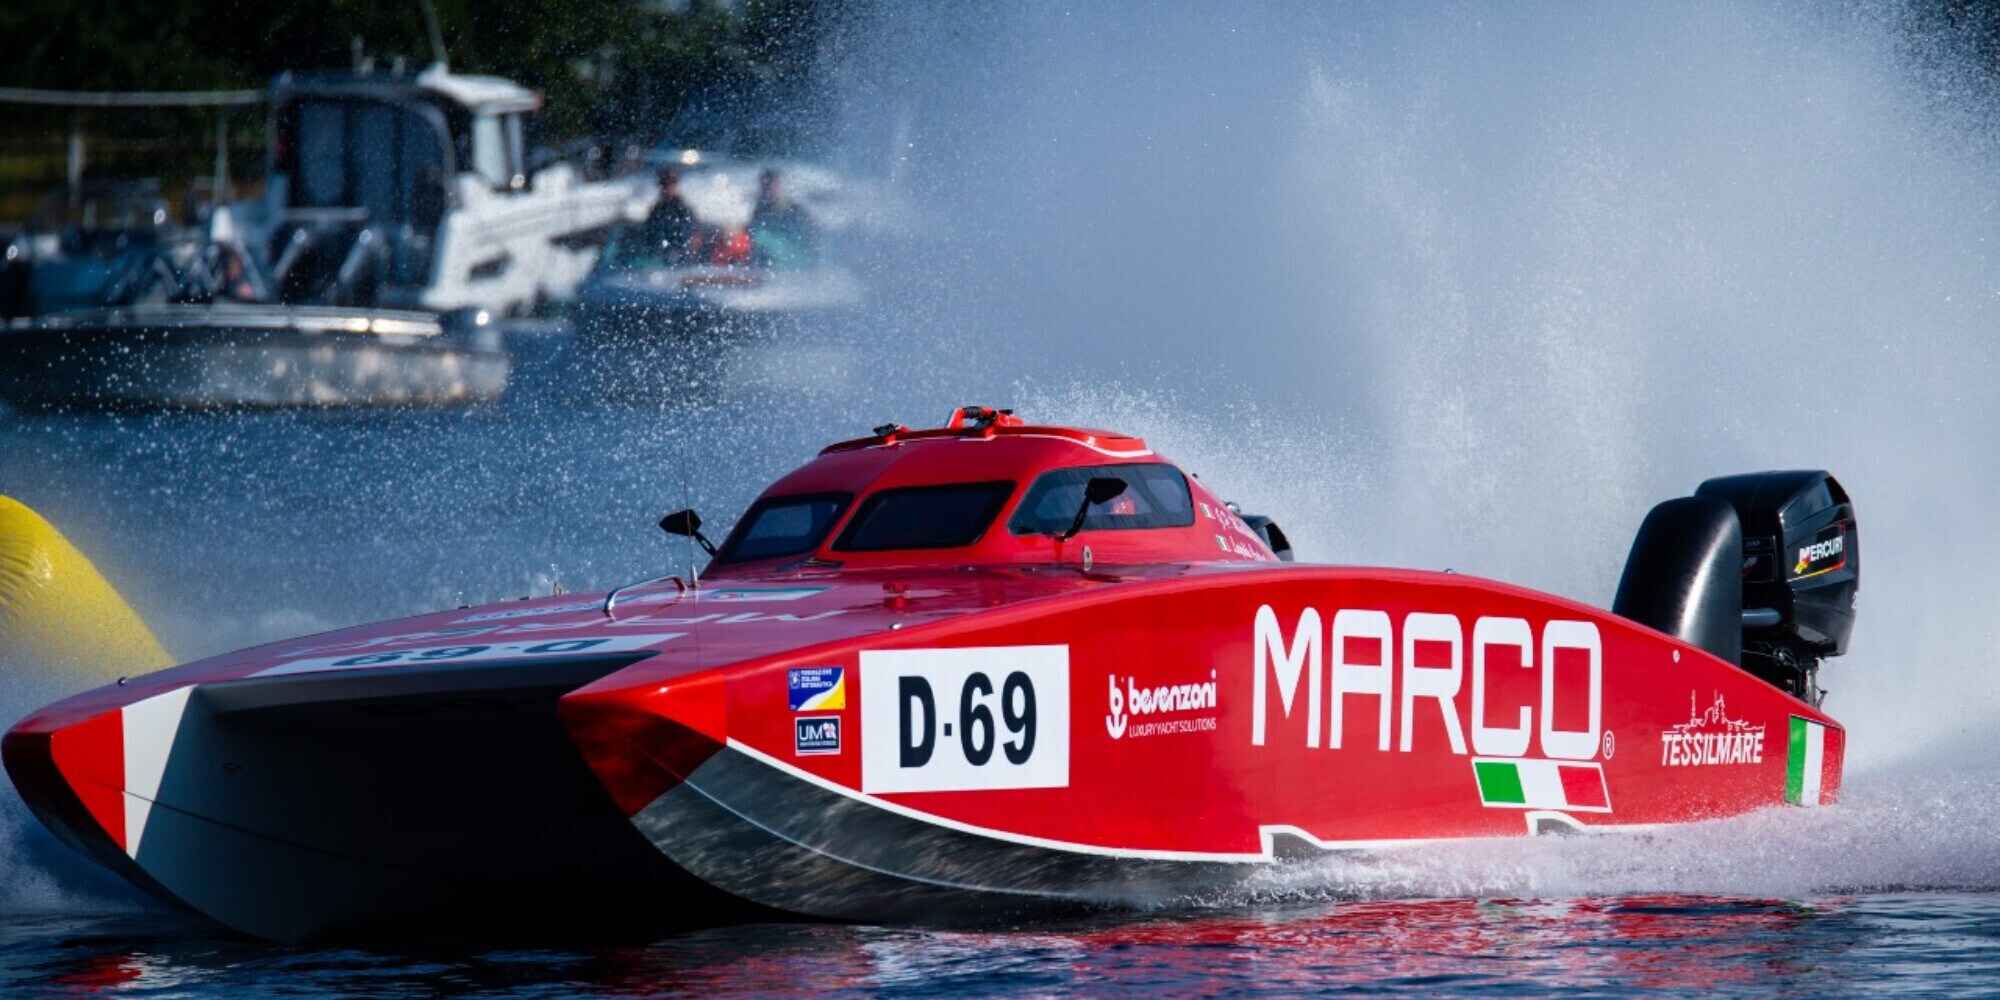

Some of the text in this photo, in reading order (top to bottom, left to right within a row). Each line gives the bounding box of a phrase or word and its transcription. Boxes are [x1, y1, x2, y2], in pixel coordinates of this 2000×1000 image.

[1251, 603, 1603, 760] MARCO
[1129, 717, 1217, 738] LUXURY YACHT SOLUTIONS
[1662, 732, 1764, 766] TESSILMARE
